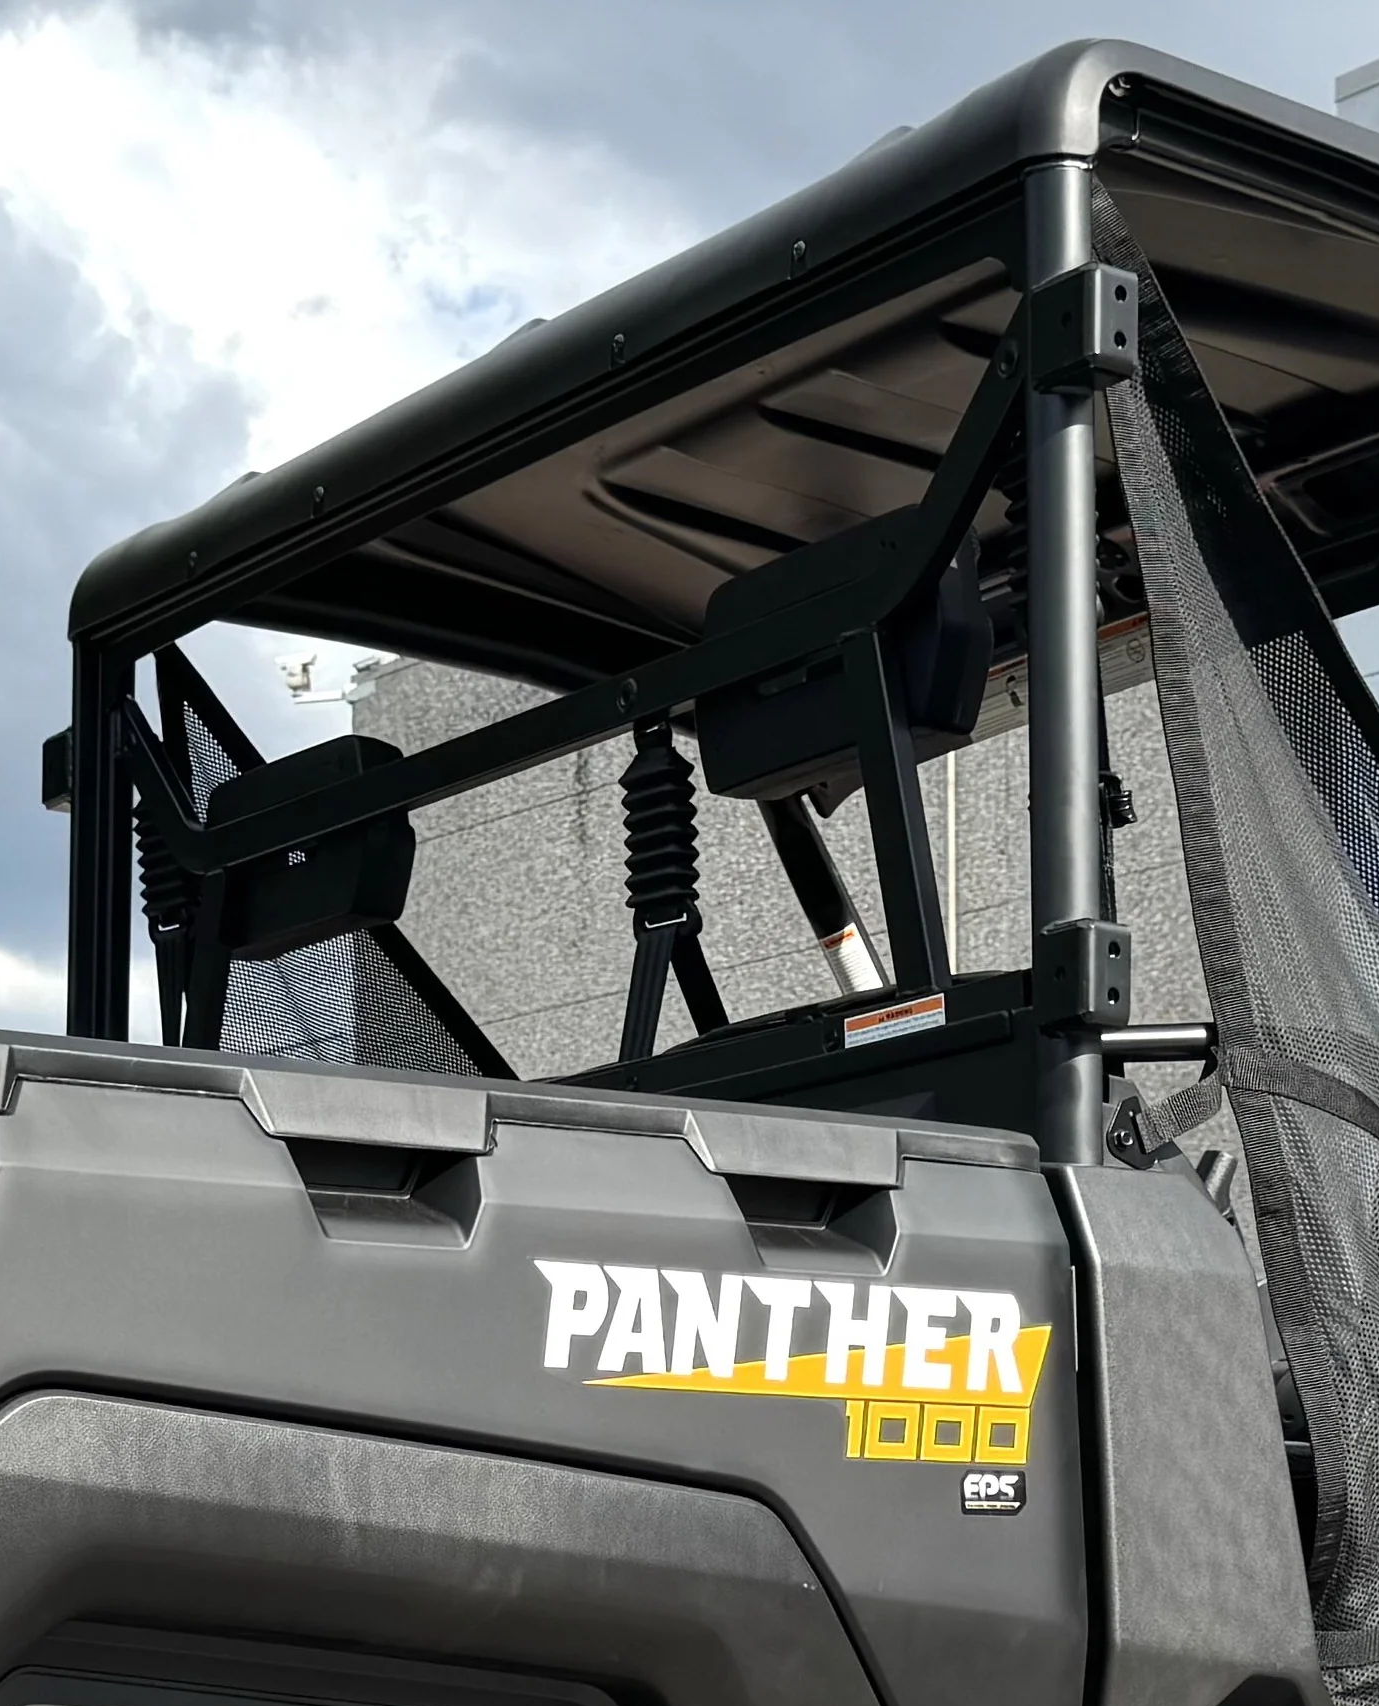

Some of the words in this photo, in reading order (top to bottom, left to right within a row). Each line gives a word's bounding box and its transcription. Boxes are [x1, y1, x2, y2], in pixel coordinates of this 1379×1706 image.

[534, 1259, 1023, 1394] PANTHER
[845, 1399, 1030, 1465] 1000
[963, 1473, 1020, 1500] EPS
